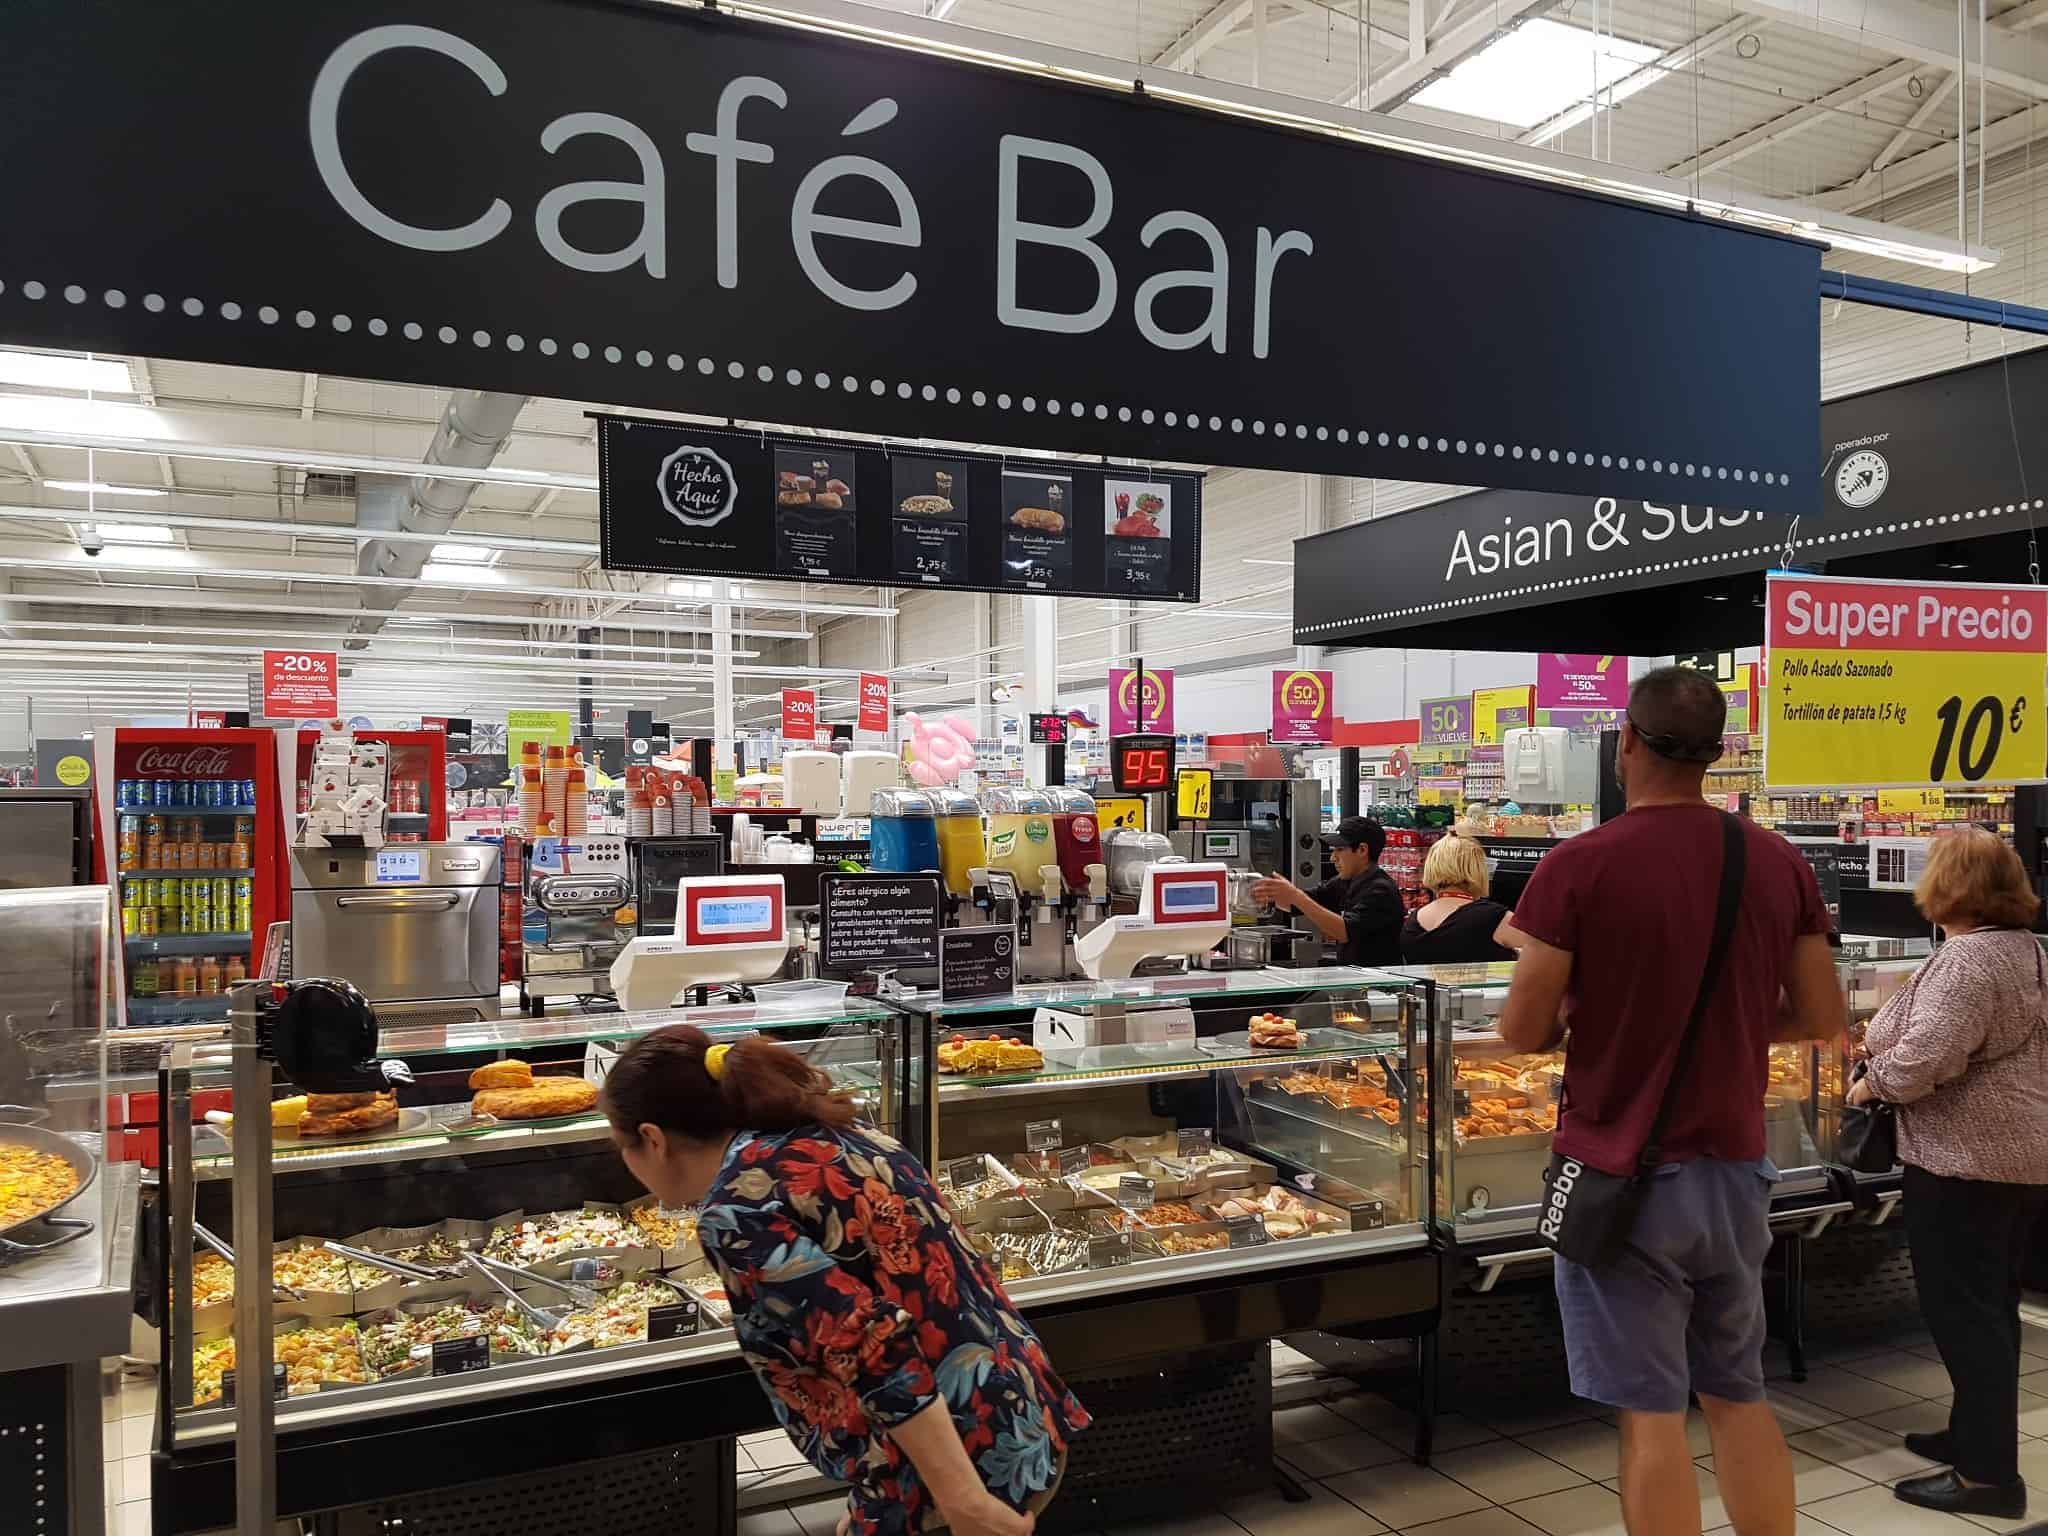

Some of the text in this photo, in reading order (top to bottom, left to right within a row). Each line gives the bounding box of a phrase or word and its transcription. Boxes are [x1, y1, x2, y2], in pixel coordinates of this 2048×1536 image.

[309, 24, 1313, 358] Café Bar
[1835, 433, 1889, 451] operado por
[674, 462, 722, 483] Hecho
[1445, 516, 1572, 581] Asian
[1586, 497, 1630, 551] &
[1785, 590, 2033, 648] Super Precio
[273, 655, 327, 673] -20%
[1782, 659, 1894, 678] Pollo Asado Sazonado
[286, 673, 329, 682] descuento
[863, 682, 887, 697] -20%
[786, 701, 814, 714] -20%
[1783, 703, 1825, 721] Tortillón
[1827, 704, 1841, 720] de
[1842, 704, 1876, 725] patata
[1894, 704, 1907, 725] kg
[1930, 695, 2026, 782] 10 €
[1123, 751, 1167, 784] 95
[857, 886, 889, 898] alérgico
[830, 898, 869, 907] alimento?
[1540, 1155, 1585, 1242] Reebo
